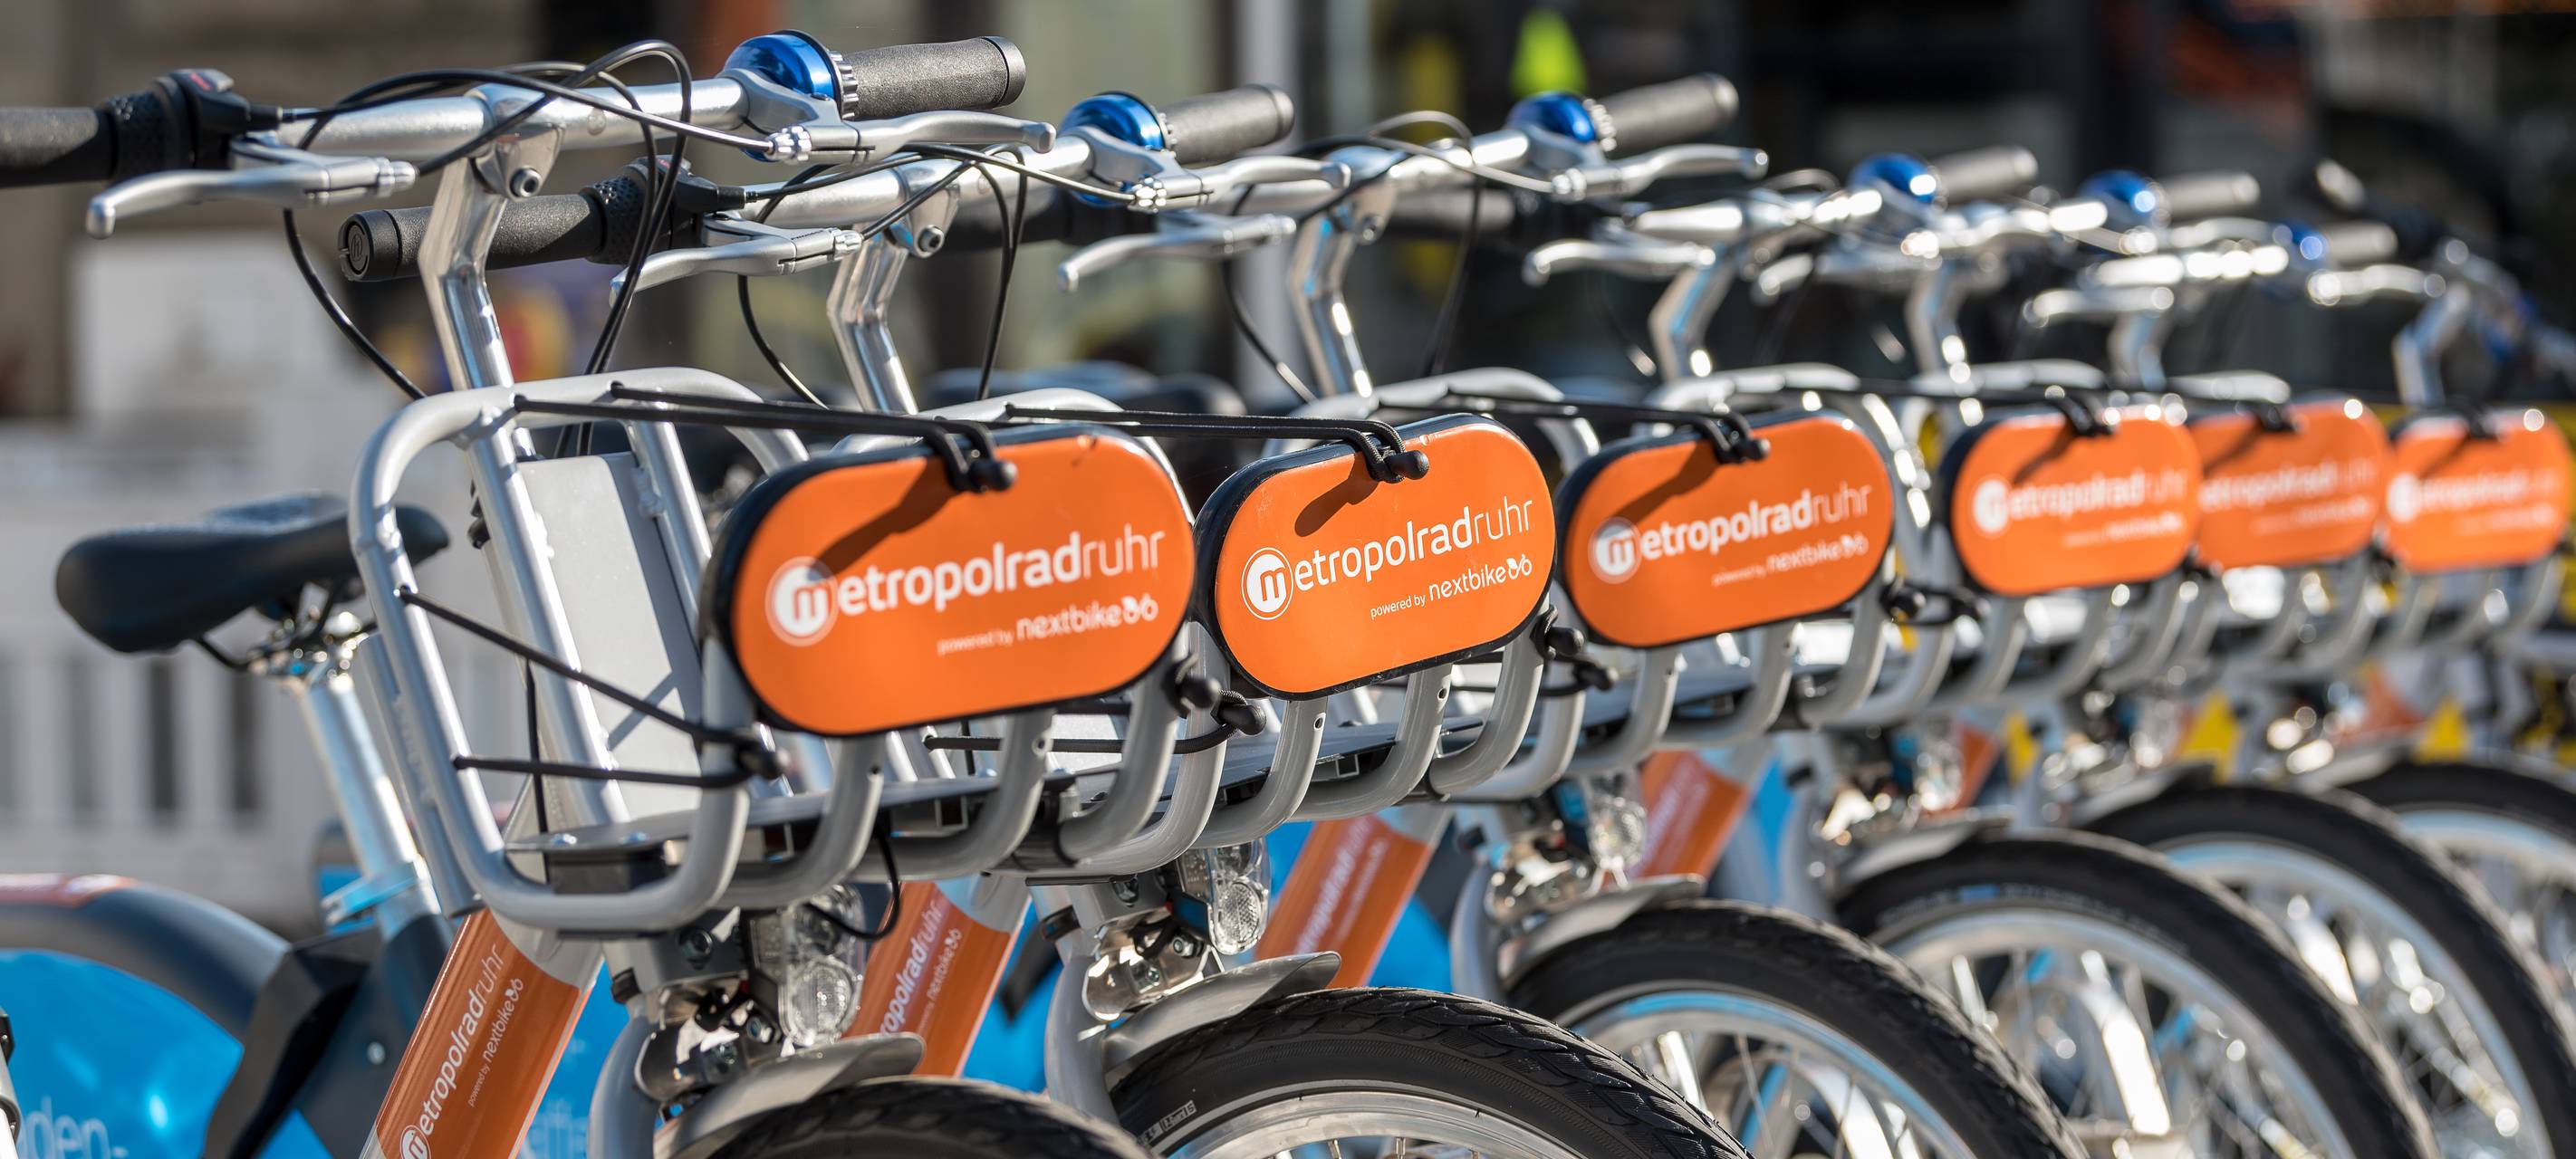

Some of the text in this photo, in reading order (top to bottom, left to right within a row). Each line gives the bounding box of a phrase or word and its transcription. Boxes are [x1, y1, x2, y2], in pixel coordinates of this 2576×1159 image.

[765, 523, 1165, 647] metropolradruhr
[1241, 495, 1533, 620] metropolradruhr
[1370, 563, 1506, 620] powered by nextbike
[1016, 599, 1121, 641] nextbike
[879, 899, 944, 1036] ropolradruhr
[467, 1071, 486, 1107] powered
[482, 1000, 515, 1063] nextbike
[18, 1094, 129, 1159] den-
